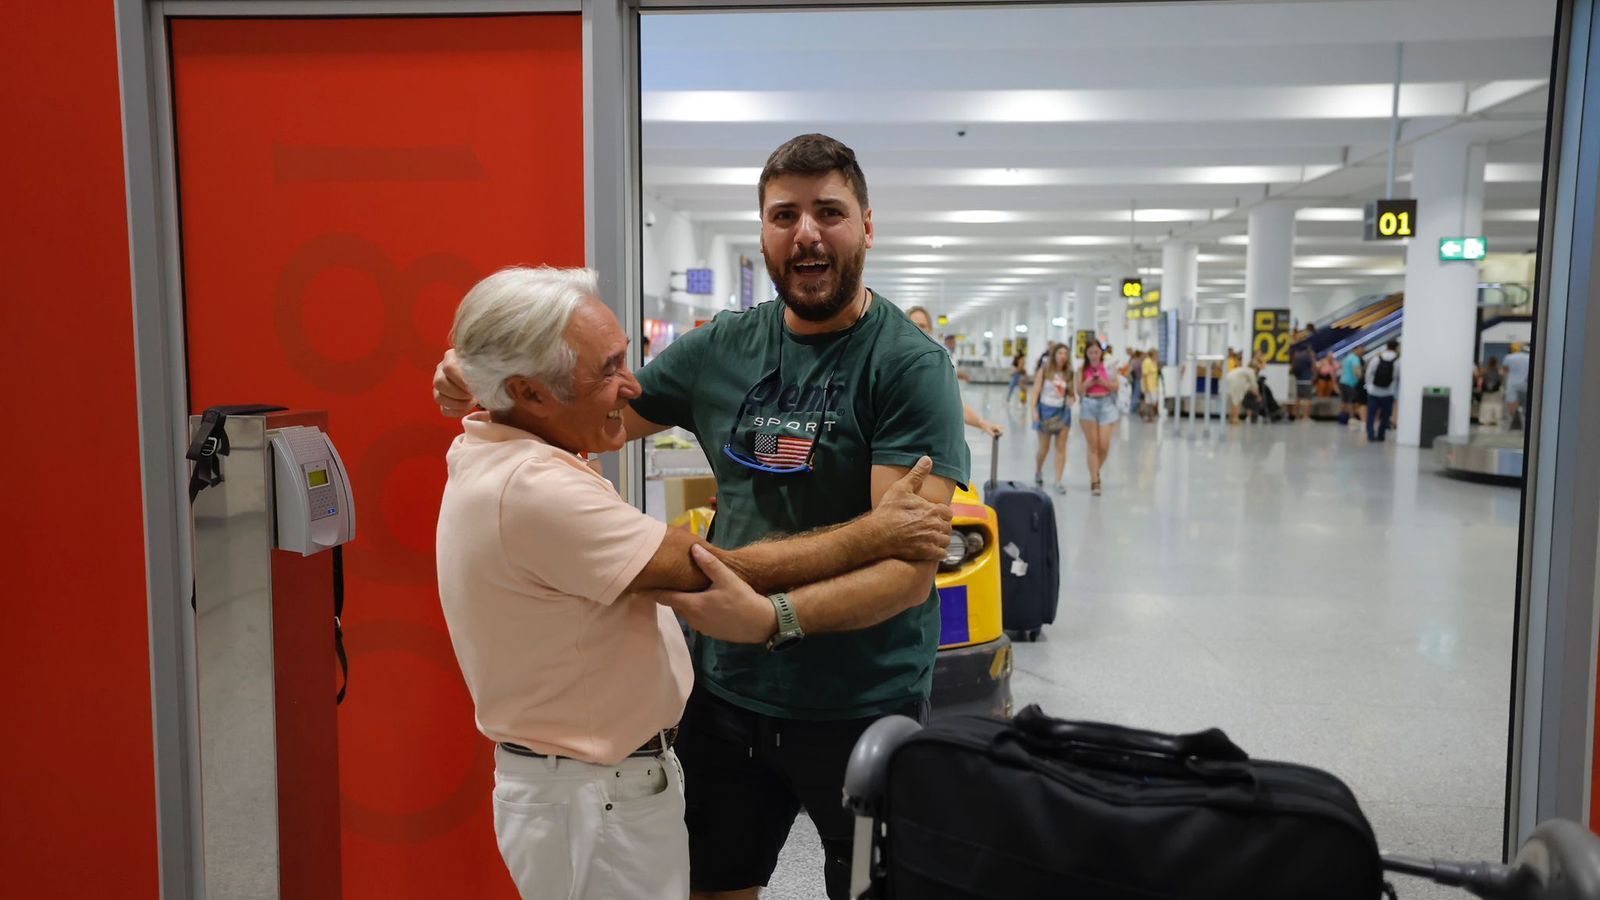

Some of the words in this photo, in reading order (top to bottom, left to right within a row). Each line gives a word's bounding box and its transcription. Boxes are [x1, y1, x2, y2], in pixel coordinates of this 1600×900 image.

[1379, 211, 1411, 236] 01
[1254, 332, 1292, 363] 02
[753, 417, 836, 432] SPORT
